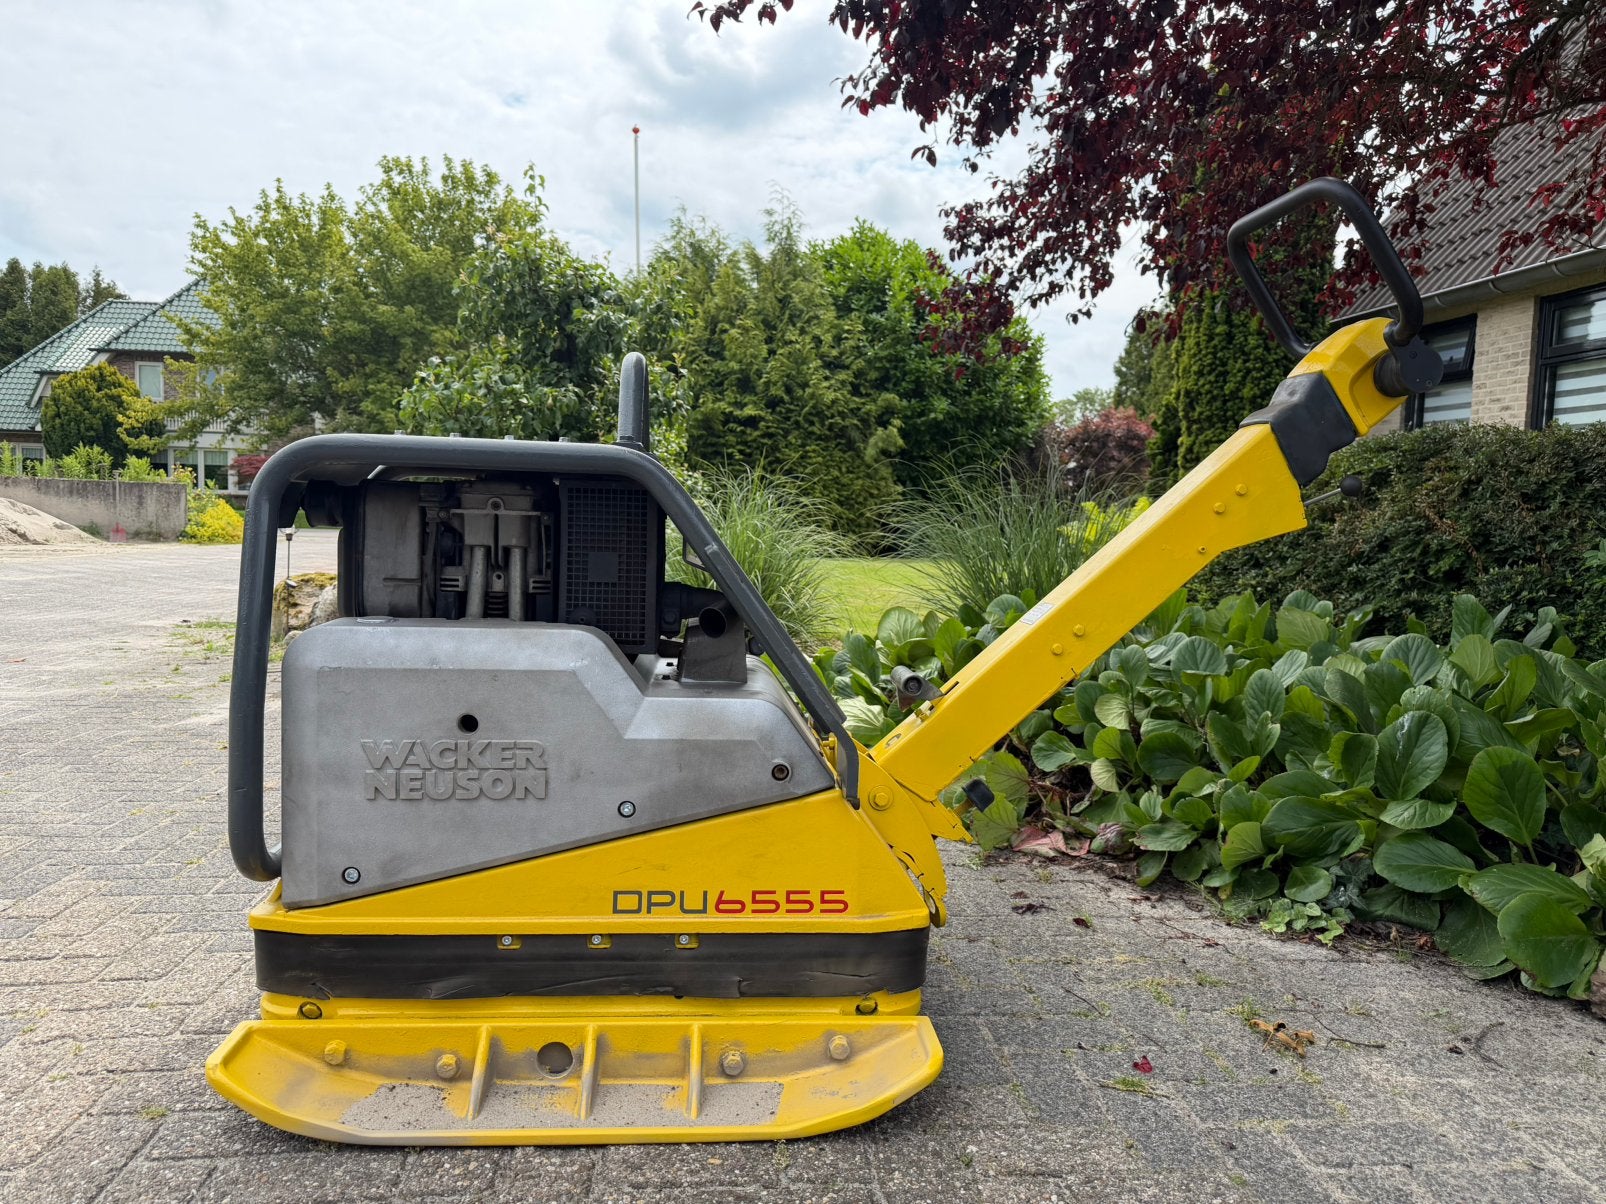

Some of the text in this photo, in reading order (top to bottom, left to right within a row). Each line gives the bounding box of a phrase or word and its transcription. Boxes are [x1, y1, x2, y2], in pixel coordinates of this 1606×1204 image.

[360, 739, 548, 769] WACKER
[365, 769, 548, 800] NEUSON
[612, 890, 849, 914] DPU6555
